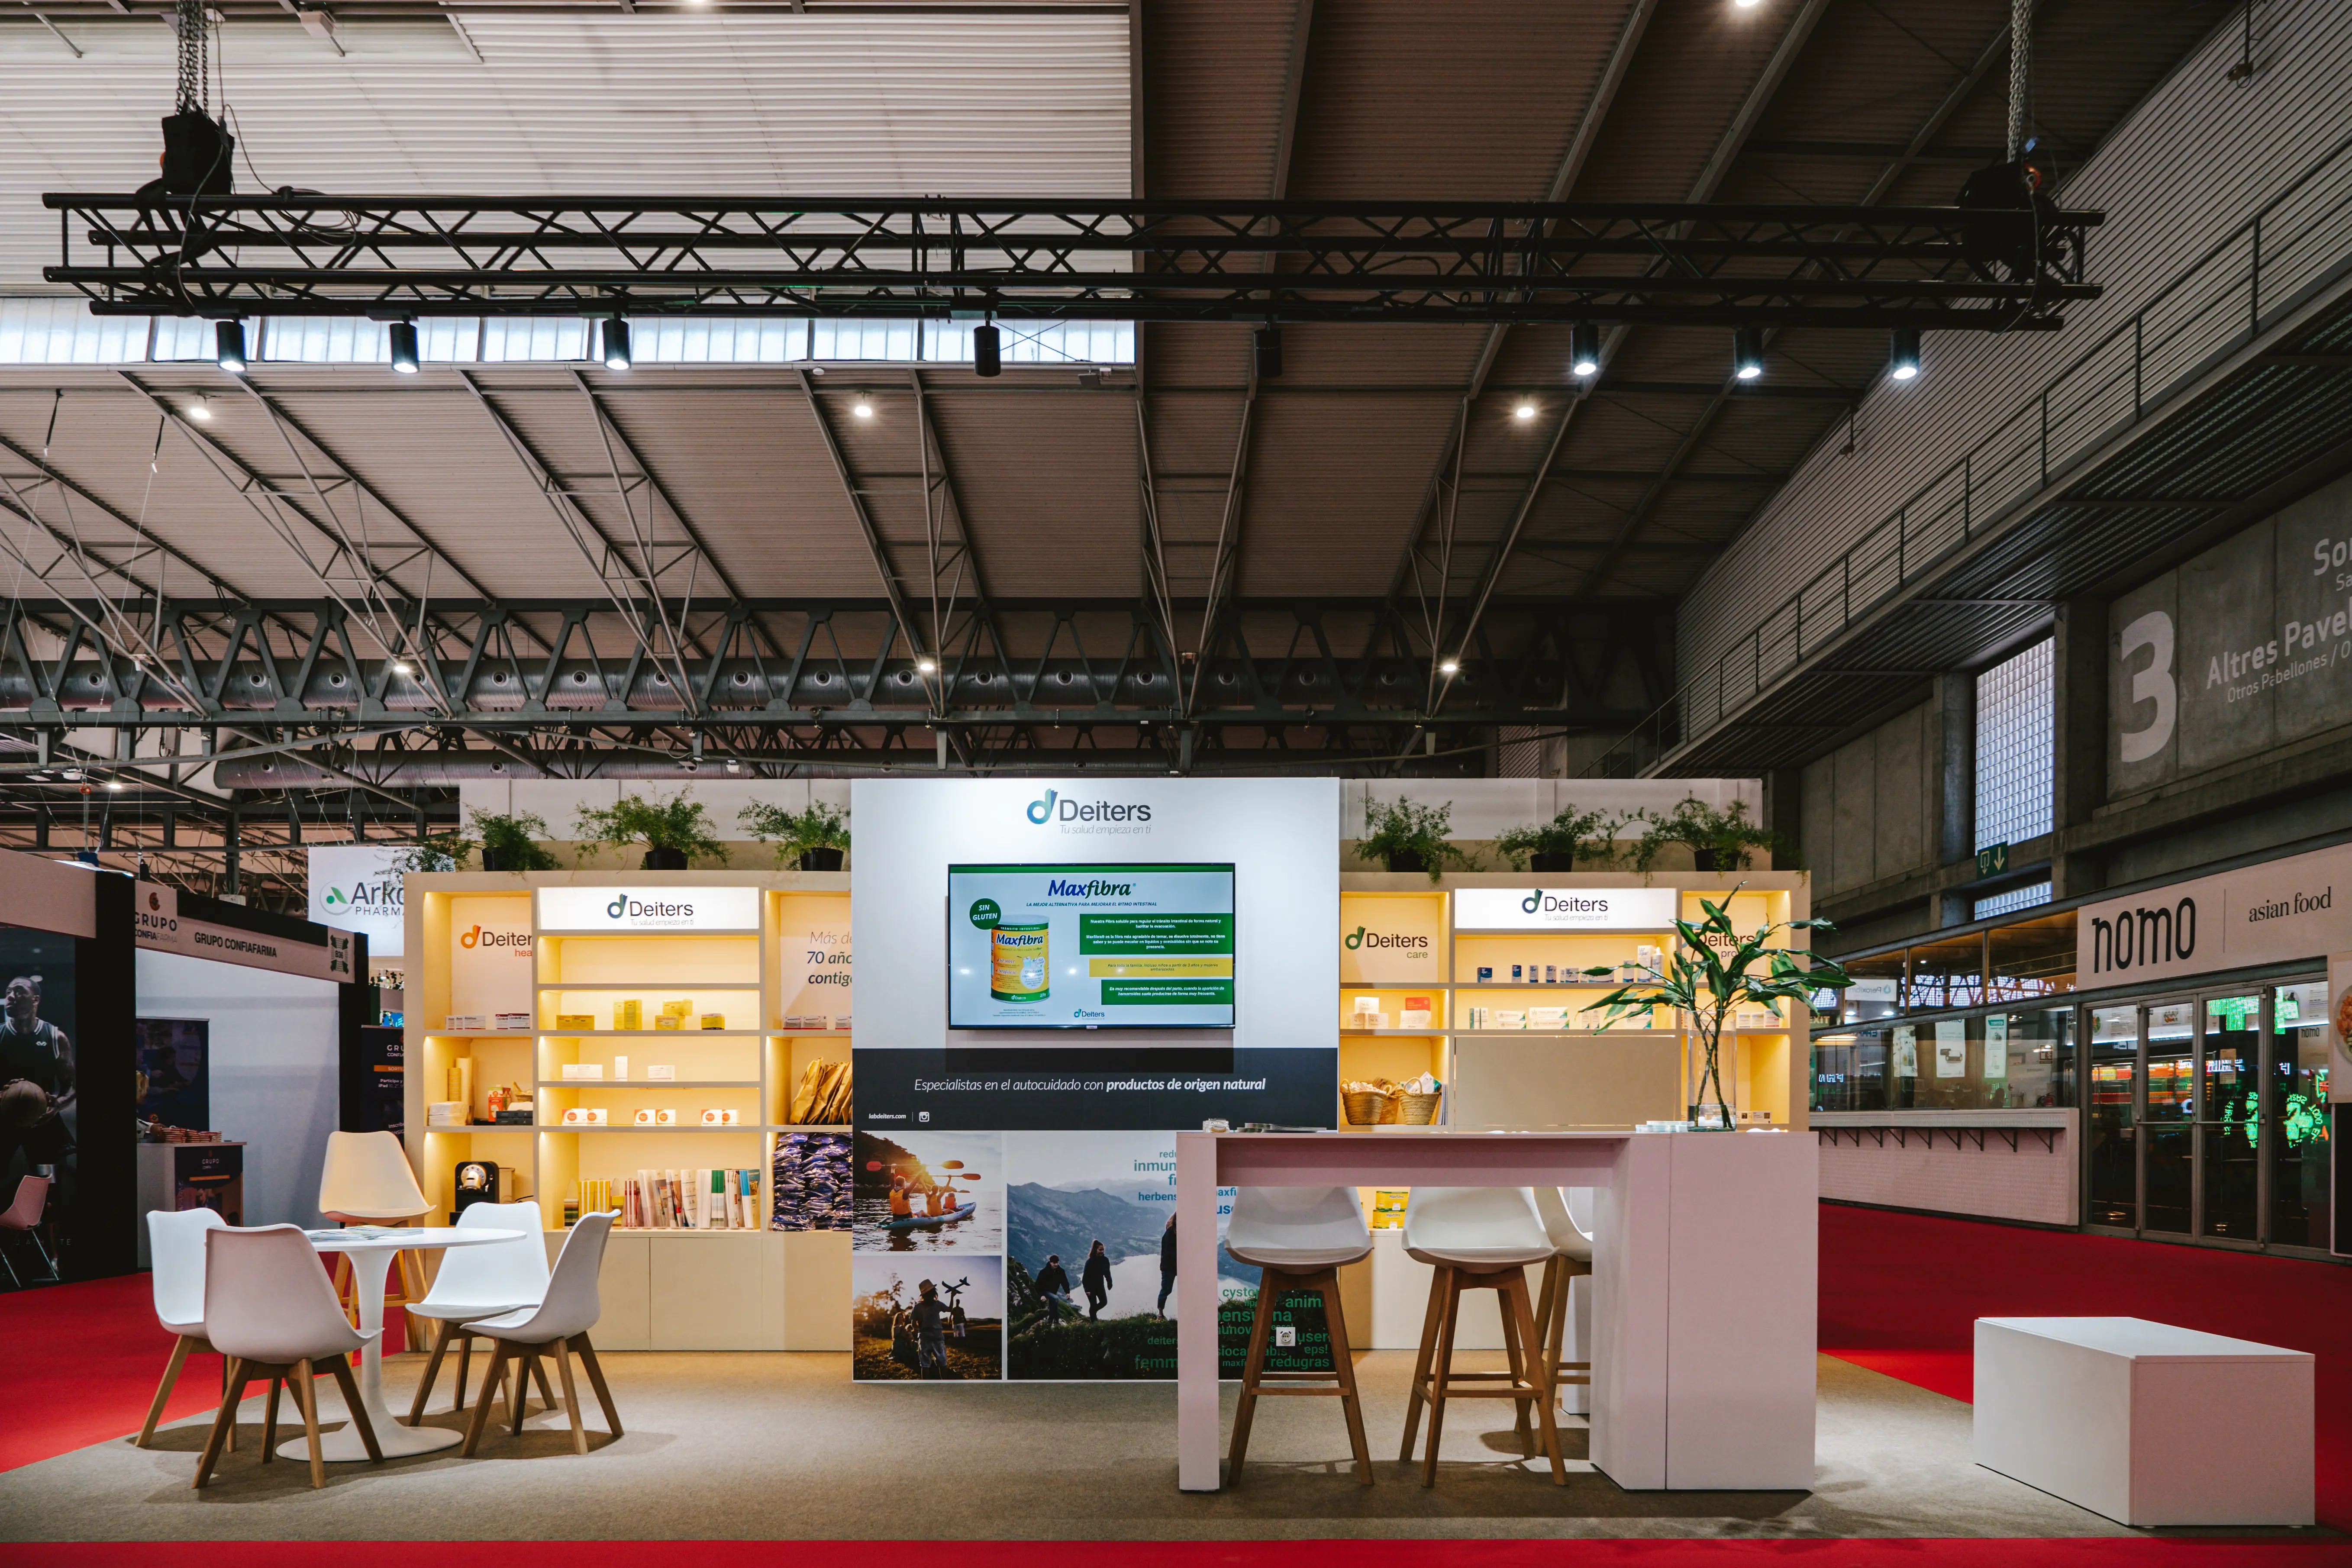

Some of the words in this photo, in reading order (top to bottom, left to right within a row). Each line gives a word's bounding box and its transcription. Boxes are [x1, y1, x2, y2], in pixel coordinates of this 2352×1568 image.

[2206, 640, 2278, 690] Altres
[2228, 681, 2258, 703] Otros
[2262, 654, 2327, 691] Pabellones
[2121, 611, 2177, 763] 3
[1060, 800, 1151, 821] Deiters
[1060, 825, 1070, 834] Tu
[1072, 825, 1094, 834] salud
[1096, 826, 1131, 836] empieza
[1145, 825, 1151, 834] ti
[356, 907, 404, 916] PHARM
[629, 901, 694, 916] Deiters
[1545, 897, 1608, 912] Deiters
[810, 931, 837, 944] Más
[2092, 897, 2196, 974] nomo
[2249, 899, 2289, 923] asian
[2294, 886, 2332, 914] food
[195, 932, 223, 948] GRUPO
[225, 938, 277, 958] CONFIAFARMA
[1367, 933, 1428, 948] Deiters
[335, 950, 344, 959] B36
[807, 951, 825, 964] 70
[1407, 950, 1428, 959] care
[808, 971, 852, 987] contig
[2301, 1028, 2320, 1038] nomo
[914, 1078, 982, 1093] Especialistas
[985, 1082, 998, 1090] en
[1001, 1078, 1010, 1090] el
[1013, 1078, 1081, 1090] autocuidado
[1084, 1081, 1103, 1090] con
[1106, 1078, 1165, 1093] productos
[1167, 1078, 1182, 1090] de
[1184, 1078, 1220, 1093] origen
[1223, 1078, 1266, 1090] natural
[1147, 1336, 1178, 1345] deiter
[1304, 1344, 1328, 1356] eps!
[1271, 1355, 1329, 1370] redugras
